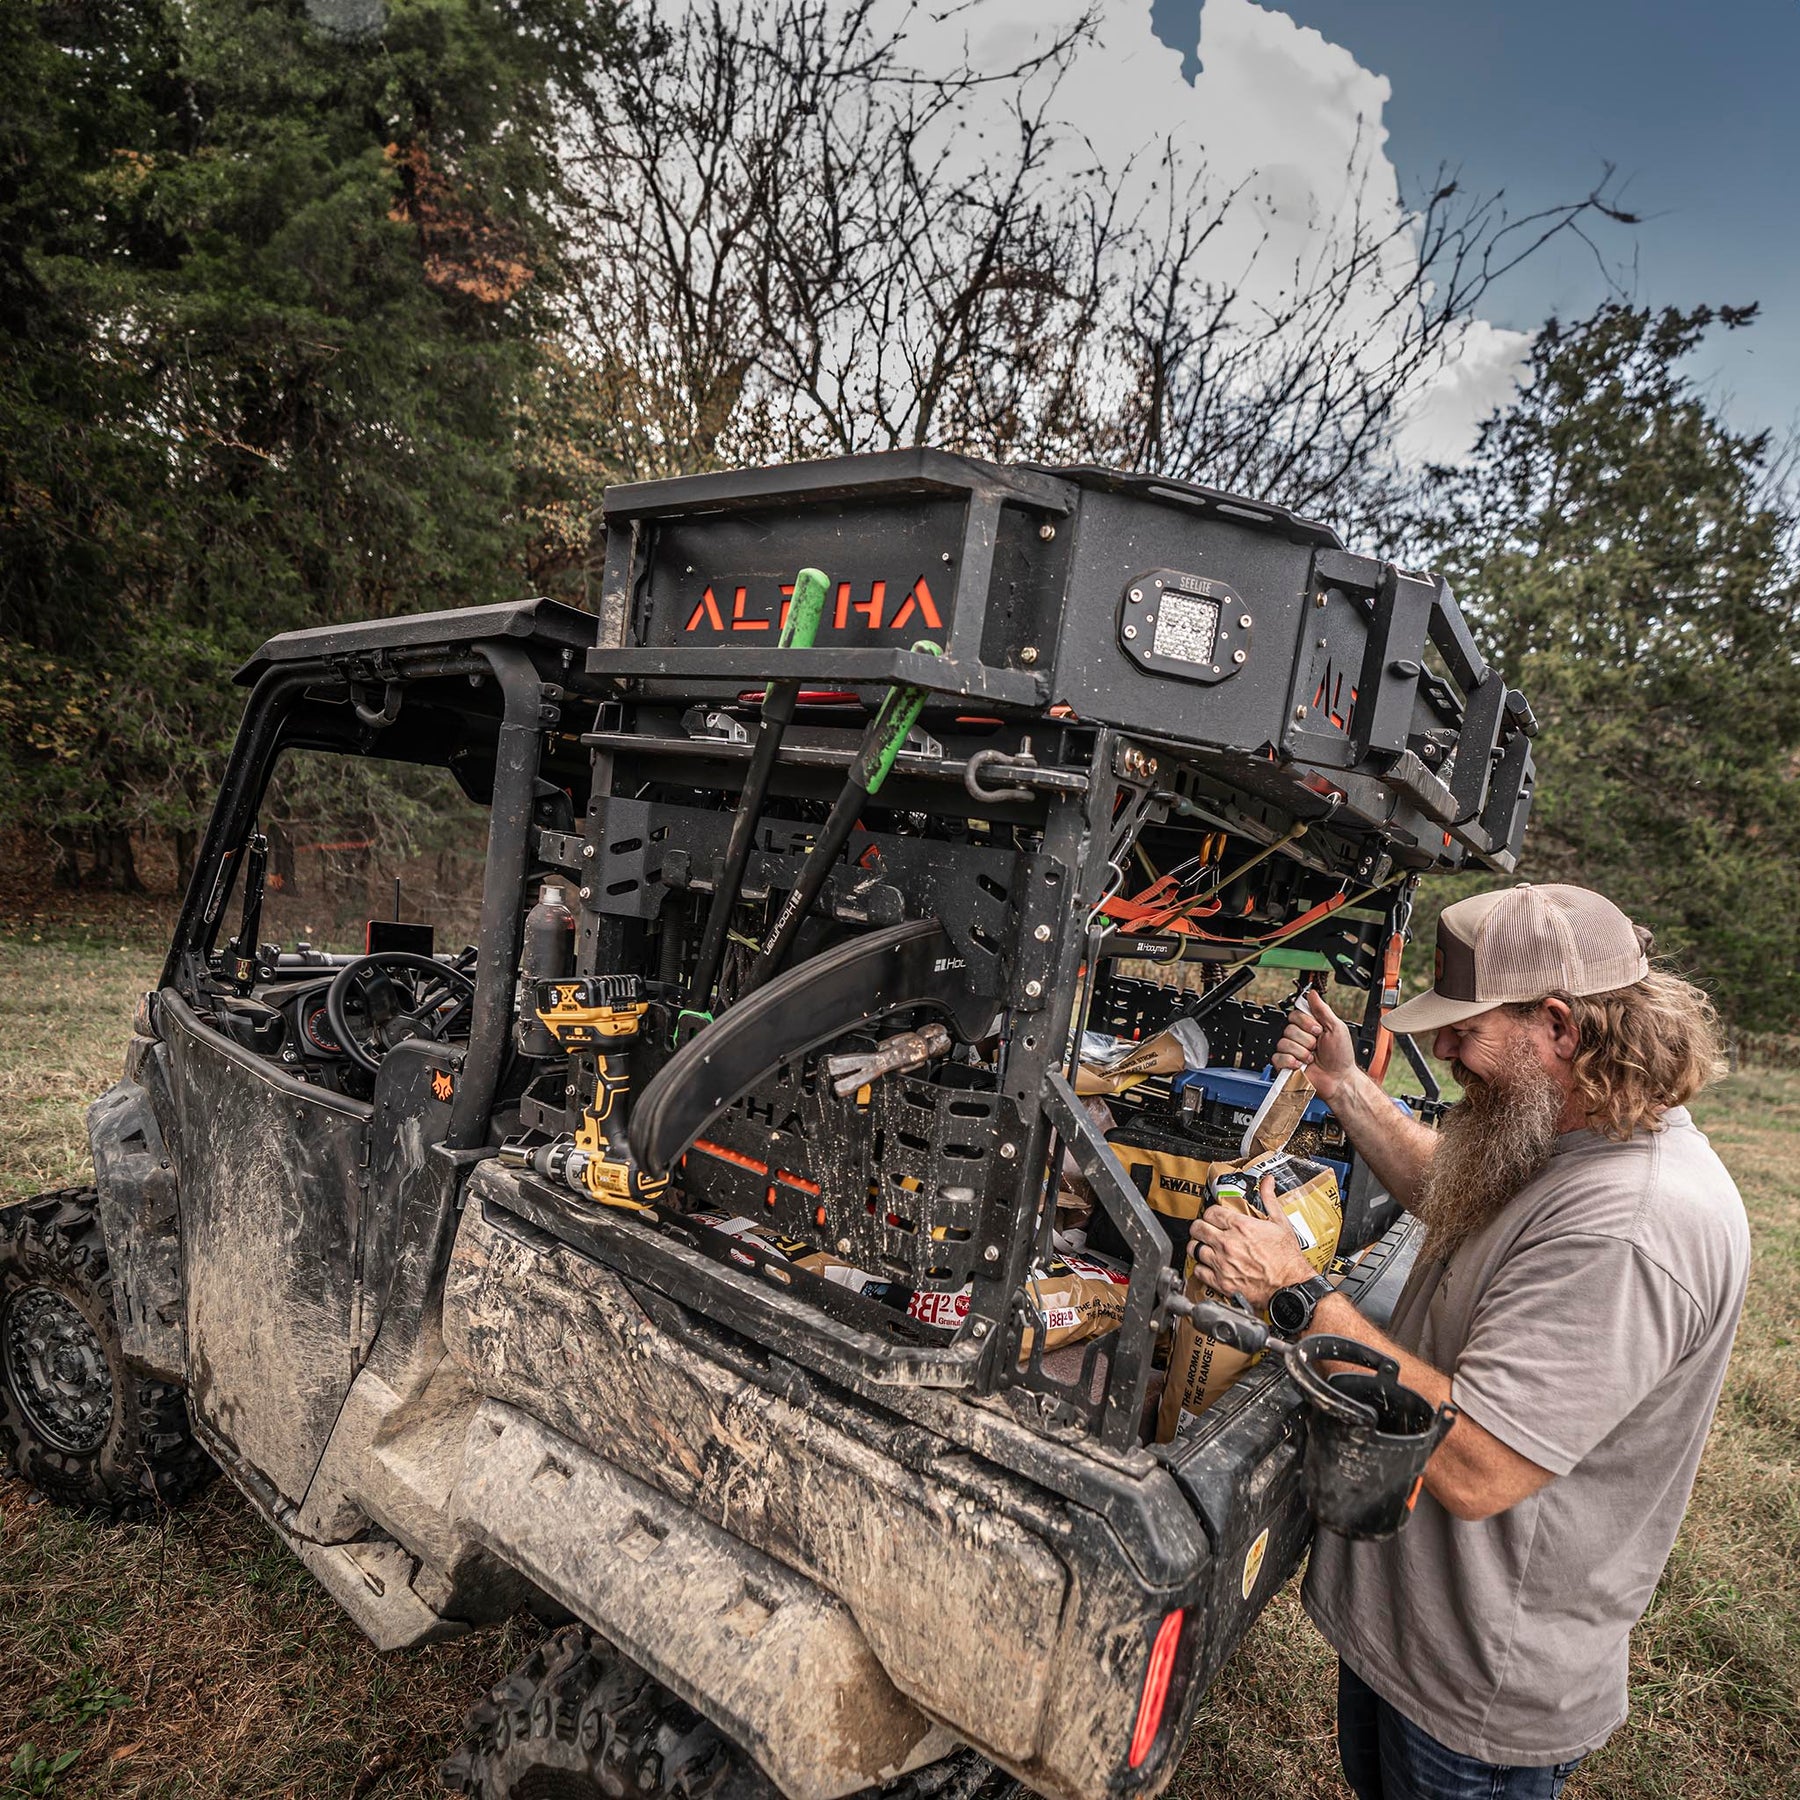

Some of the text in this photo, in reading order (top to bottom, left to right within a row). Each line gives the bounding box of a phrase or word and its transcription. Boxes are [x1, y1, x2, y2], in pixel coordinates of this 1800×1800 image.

[1180, 576, 1211, 594] SEELITE
[763, 901, 797, 956] Hooyman
[1181, 1388, 1192, 1408] THE
[1187, 1350, 1201, 1386] AROMA
[1199, 1349, 1214, 1385] RANGE
[1193, 1386, 1206, 1406] THE
